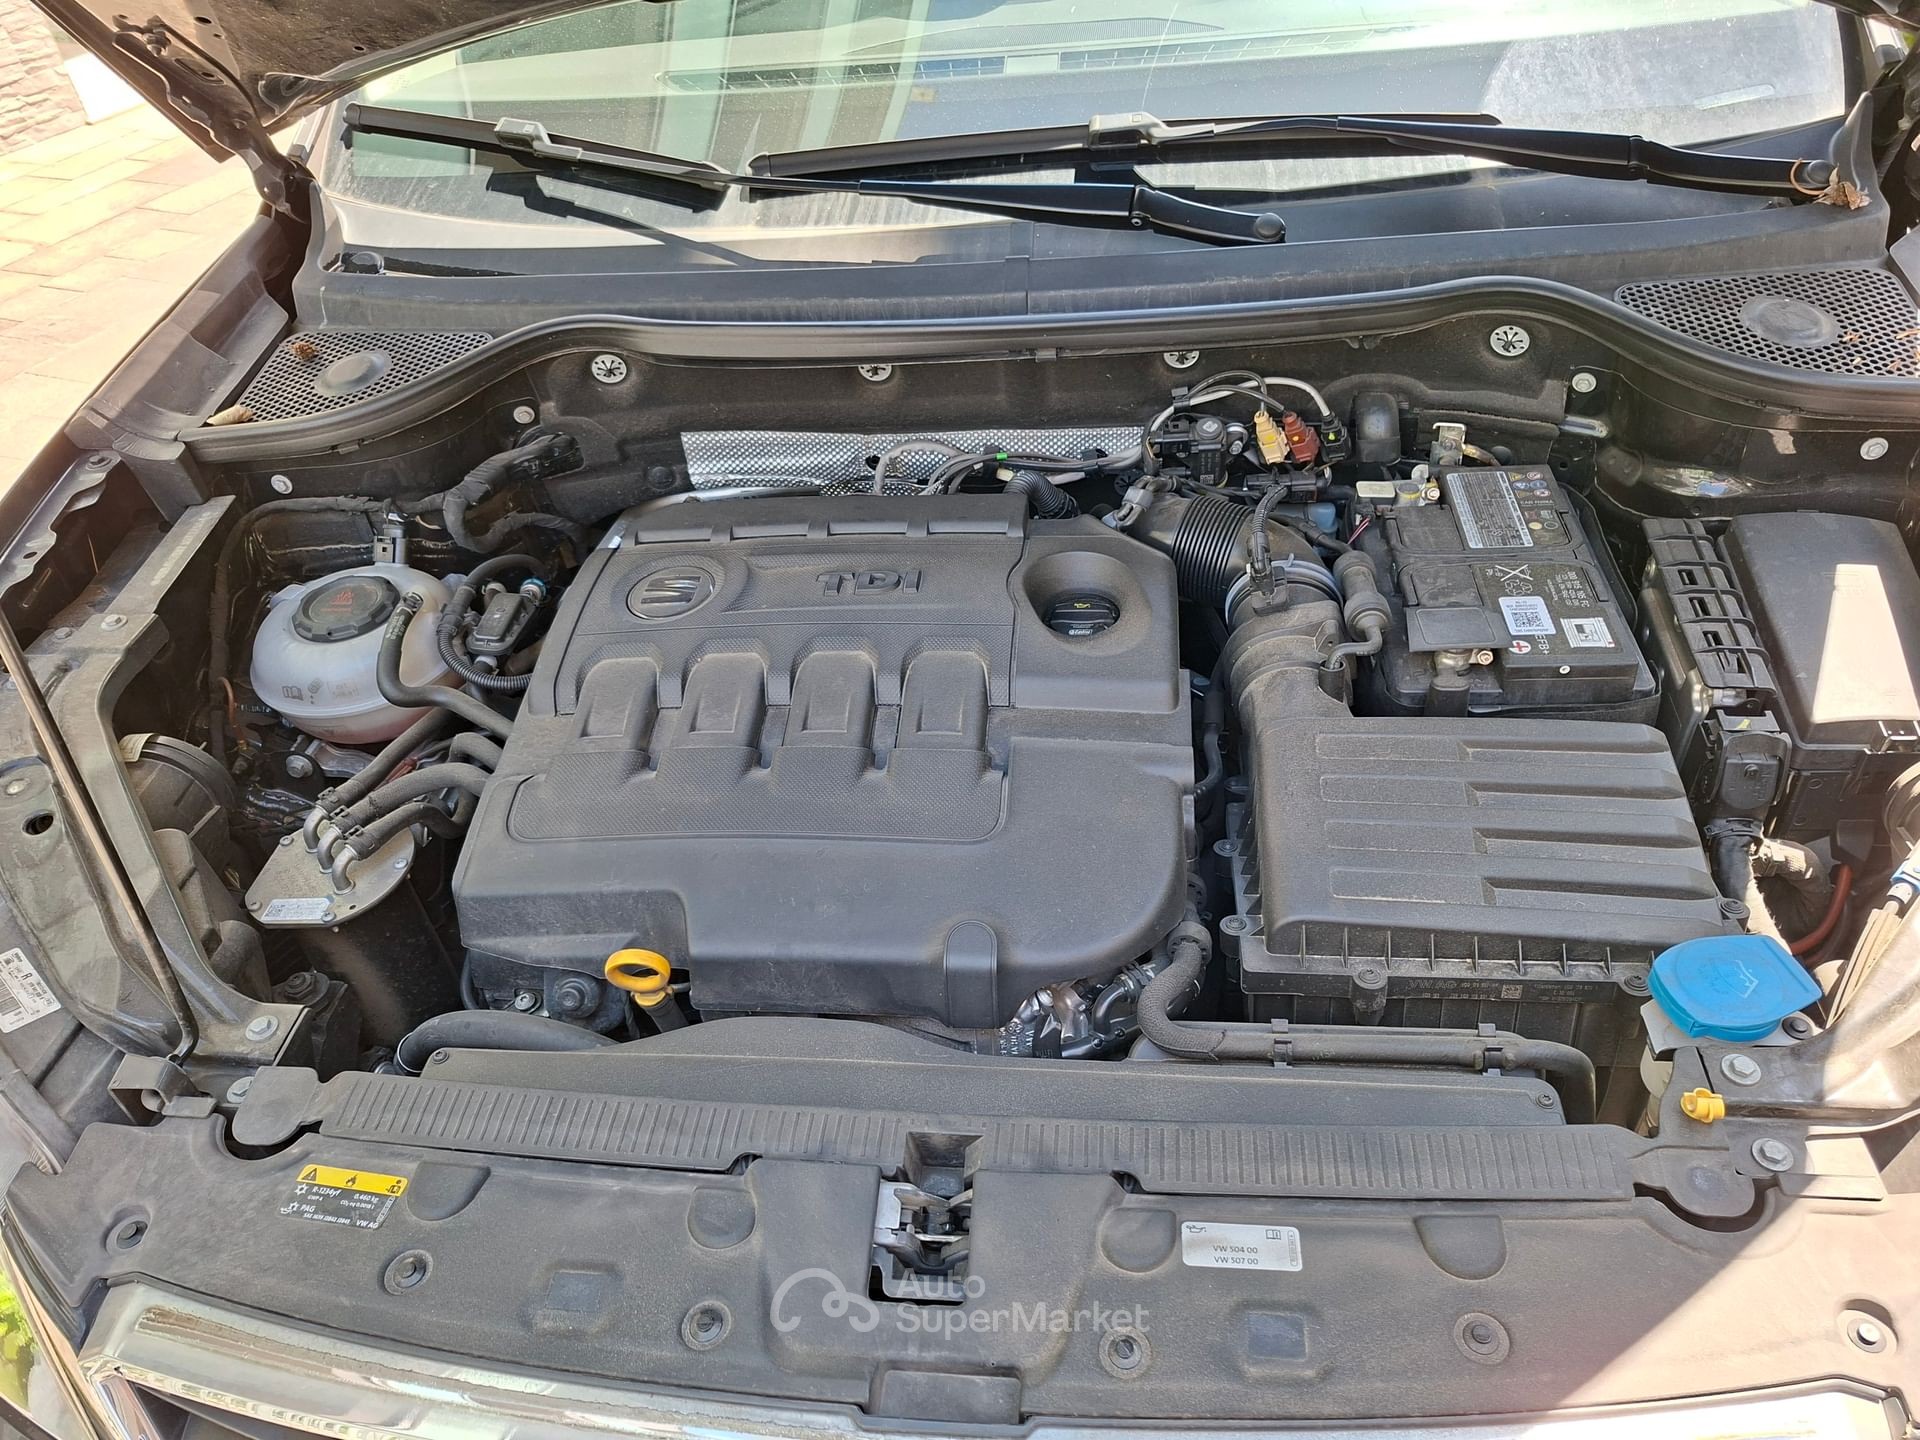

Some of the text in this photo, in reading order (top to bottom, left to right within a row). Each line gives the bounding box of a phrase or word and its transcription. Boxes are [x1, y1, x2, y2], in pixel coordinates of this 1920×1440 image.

[816, 569, 924, 597] TDI
[312, 1187, 341, 1197] R-1234yf
[300, 1204, 315, 1212] PAG
[356, 1219, 368, 1227] VW
[367, 1221, 379, 1229] AG
[1213, 1245, 1227, 1253] VW
[1247, 1246, 1258, 1254] 00
[1214, 1256, 1259, 1265] VW 507 00
